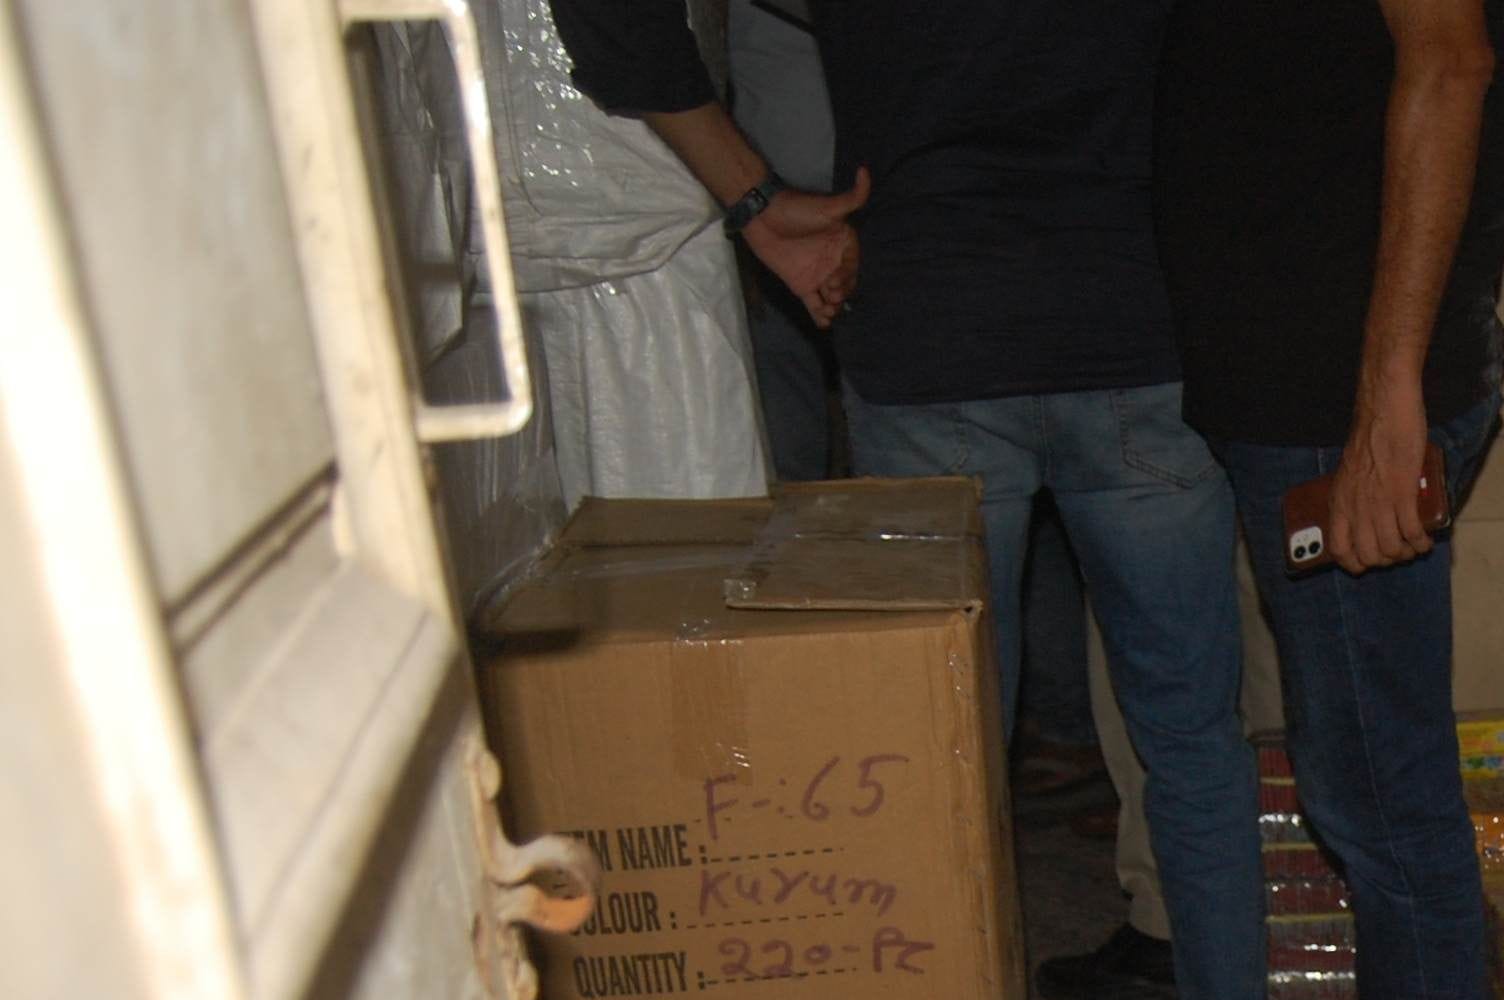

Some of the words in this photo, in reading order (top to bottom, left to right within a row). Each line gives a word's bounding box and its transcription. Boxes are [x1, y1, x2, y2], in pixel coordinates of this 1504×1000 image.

[616, 824, 693, 871] NAME
[569, 891, 661, 936] OLOUR
[573, 951, 688, 999] QUANTITY
